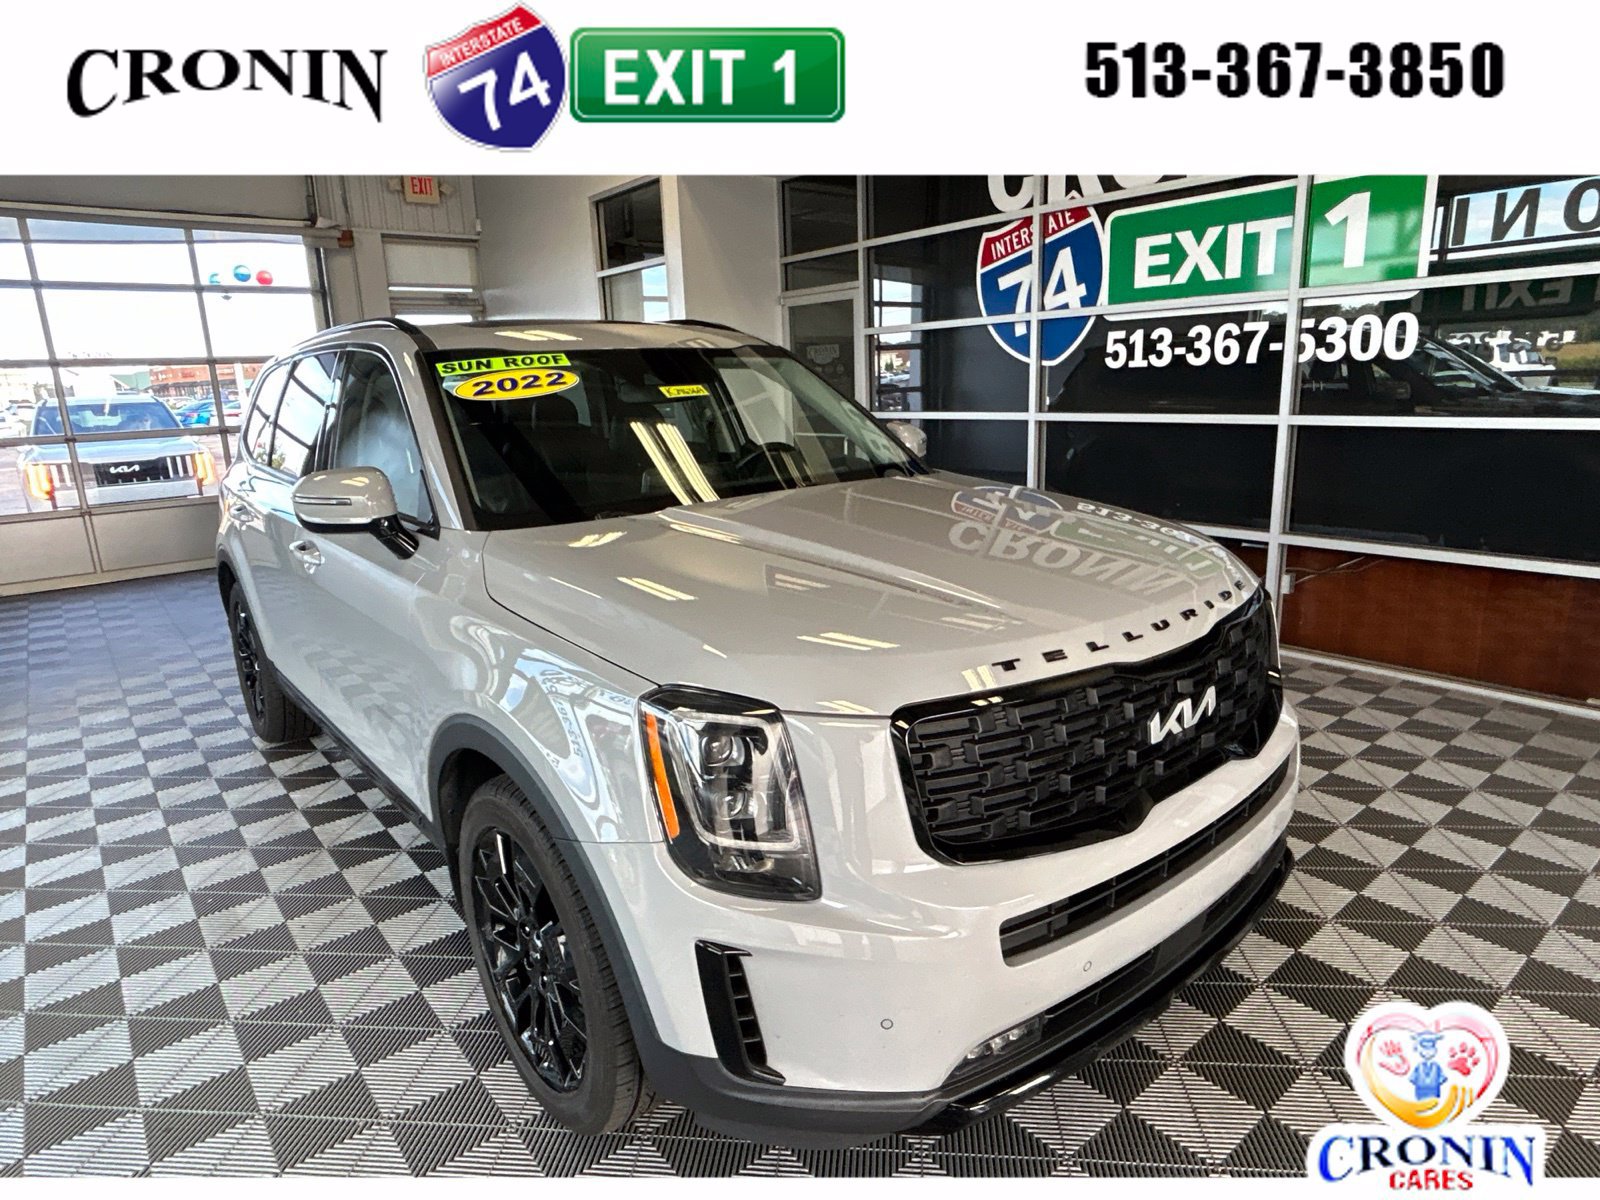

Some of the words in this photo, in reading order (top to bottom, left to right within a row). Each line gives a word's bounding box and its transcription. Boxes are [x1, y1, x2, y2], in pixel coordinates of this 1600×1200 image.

[410, 176, 433, 195] EXIT
[1134, 215, 1294, 289] EXIT
[1324, 191, 1371, 269] 1
[997, 246, 1087, 338] 74
[441, 359, 492, 374] SUN
[501, 354, 564, 369] ROOF
[1104, 311, 1419, 370] 513-367-5300
[472, 372, 568, 397] 2022
[991, 579, 1246, 672] TELLURIDE
[1150, 685, 1216, 745] KIA
